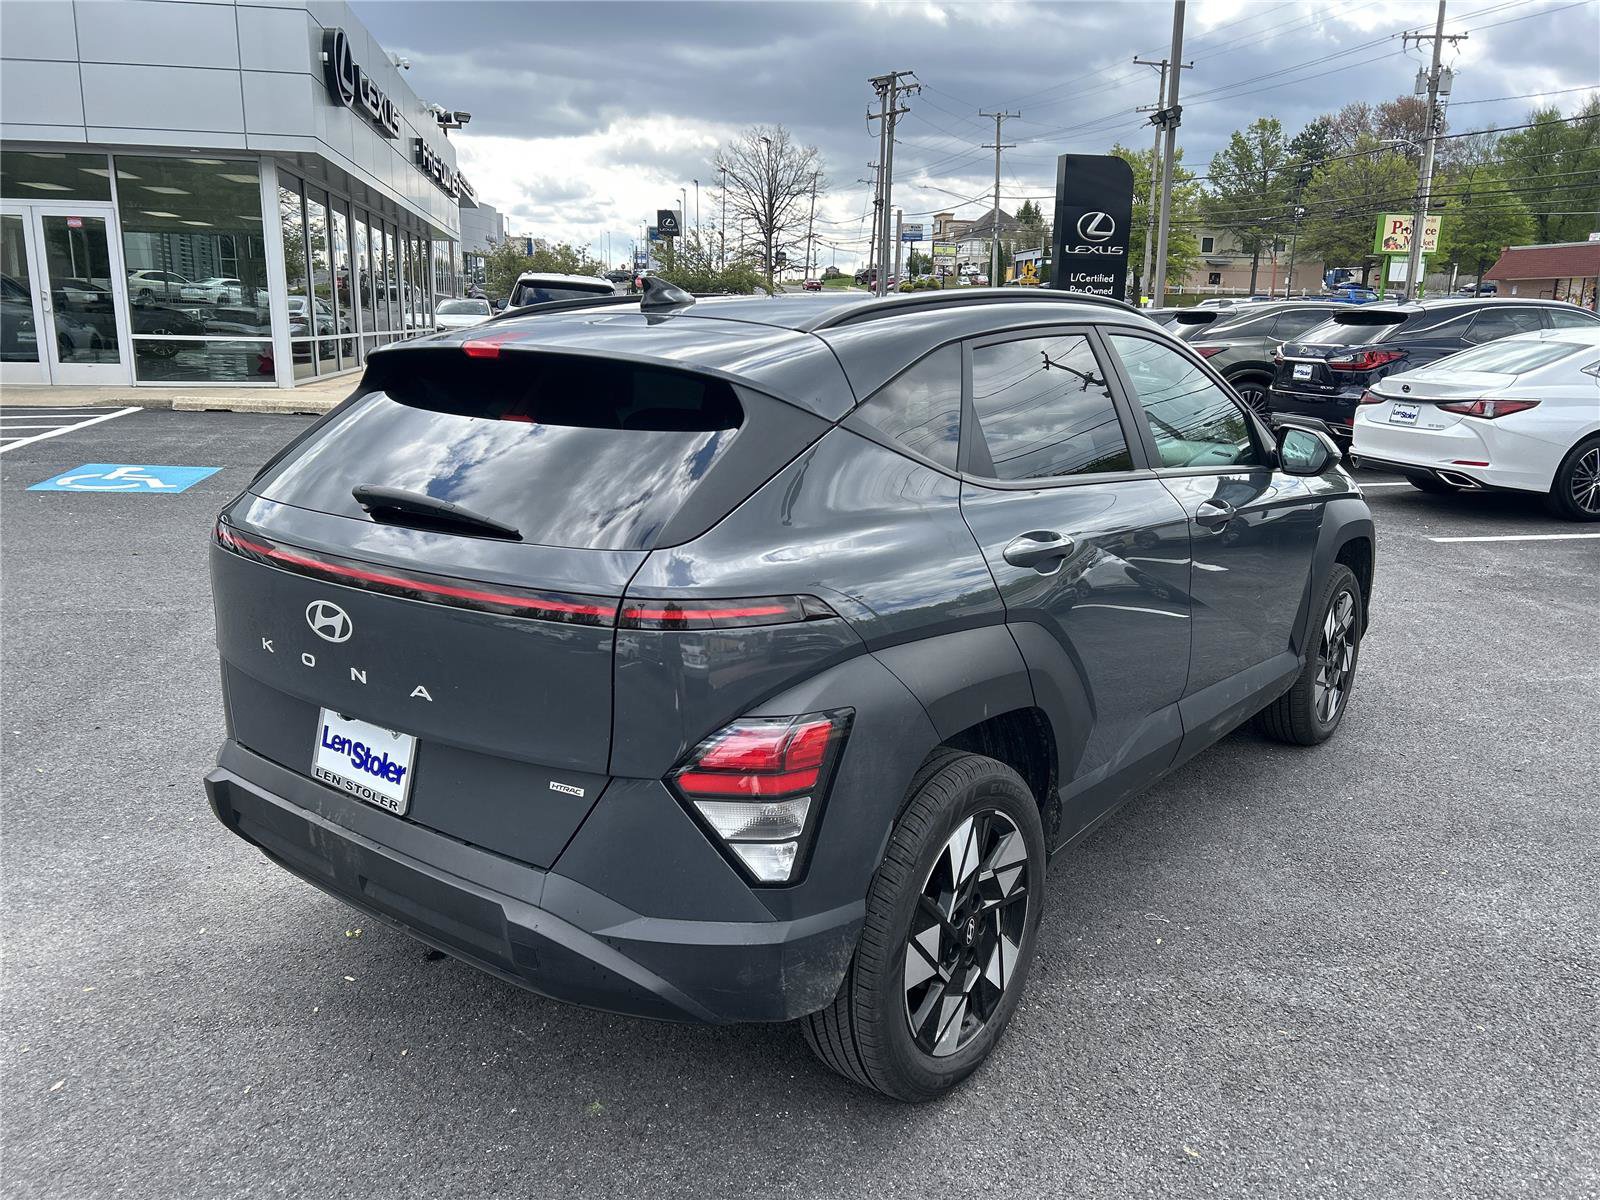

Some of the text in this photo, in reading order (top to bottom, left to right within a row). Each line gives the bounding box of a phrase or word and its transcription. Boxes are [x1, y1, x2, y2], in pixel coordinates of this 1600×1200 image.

[354, 65, 400, 139] LEXUS
[1391, 220, 1437, 236] Proce
[1403, 235, 1434, 247] Mket
[1065, 244, 1124, 255] LEXUS
[1070, 272, 1114, 283] L/Certified
[1070, 286, 1113, 295] Pre-Owned
[262, 637, 433, 702] KONA
[315, 767, 399, 811] LEN STOLER
[551, 783, 582, 796] HTRAC
